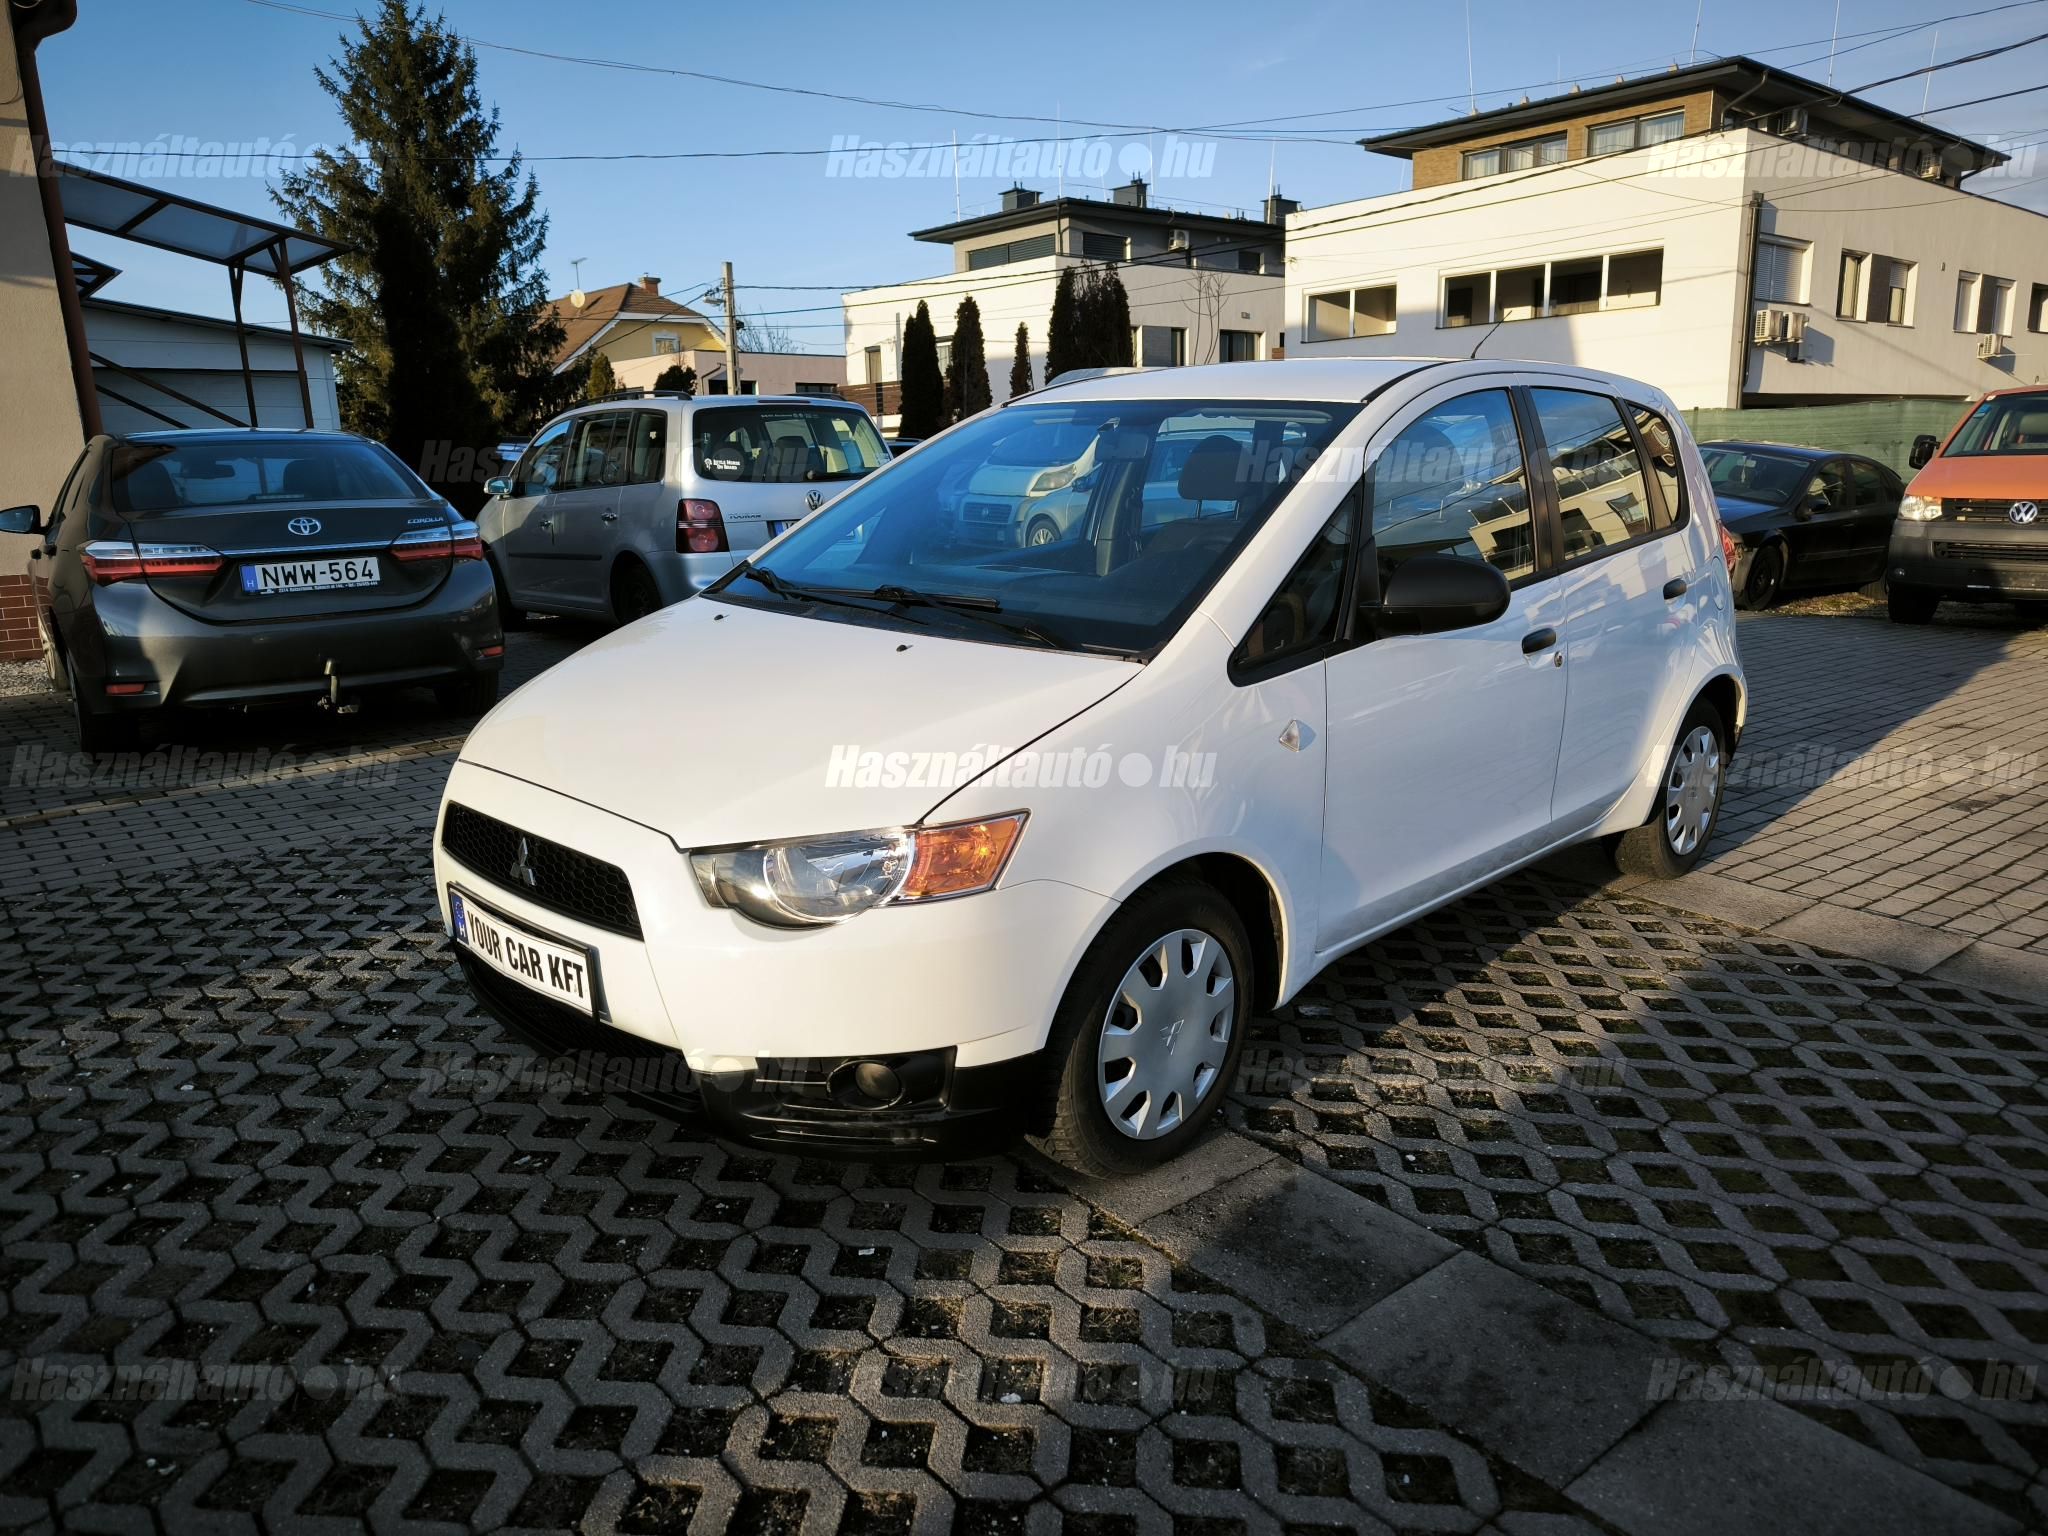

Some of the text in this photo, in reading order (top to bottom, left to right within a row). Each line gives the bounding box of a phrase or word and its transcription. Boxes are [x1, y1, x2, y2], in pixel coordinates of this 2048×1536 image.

[407, 516, 444, 524] COROLLA
[261, 560, 374, 587] NWW-564
[467, 910, 503, 963] YOUR
[505, 936, 545, 983] CAR
[547, 953, 584, 999] KFT
